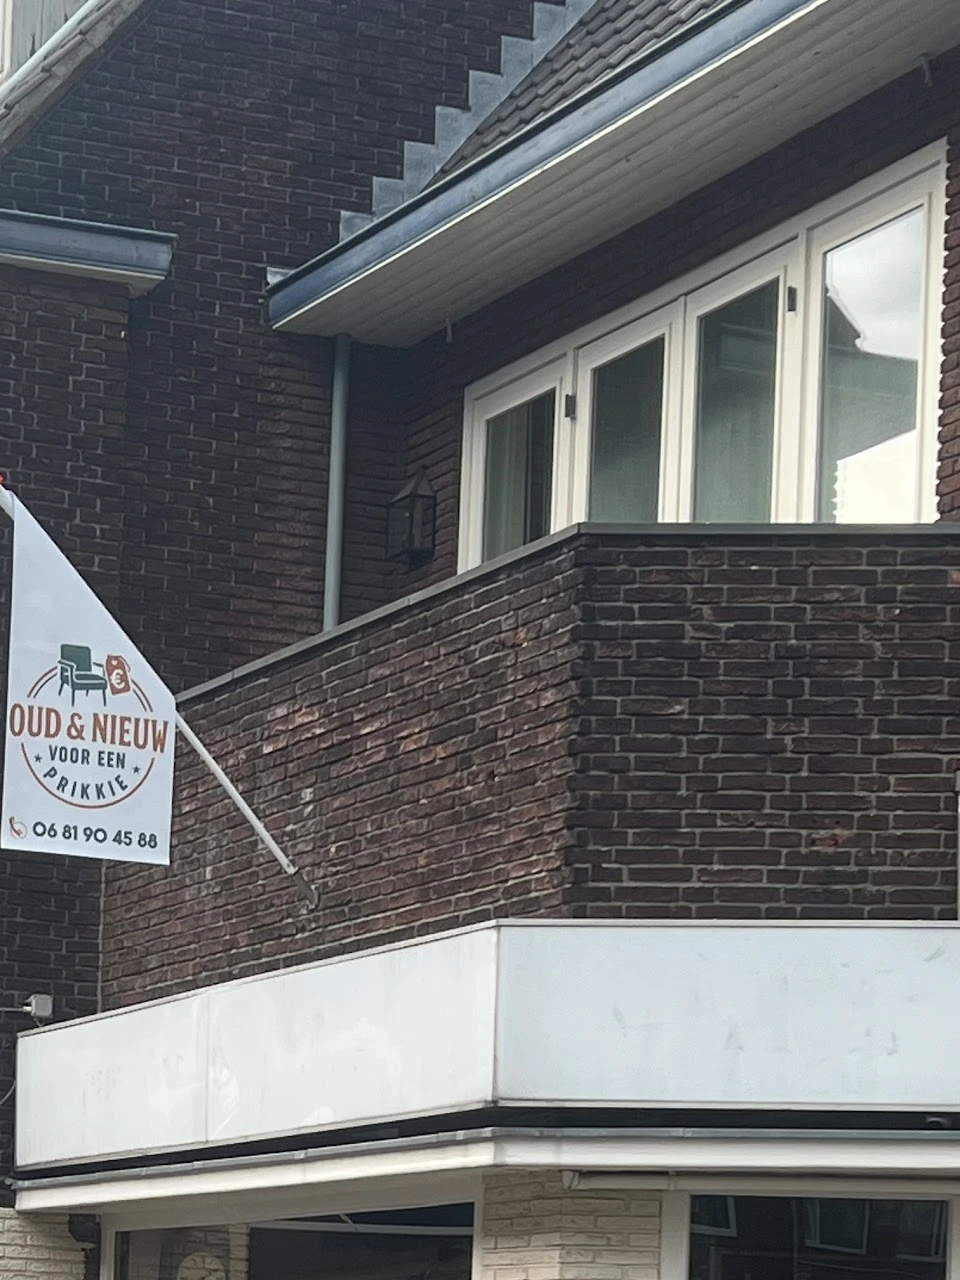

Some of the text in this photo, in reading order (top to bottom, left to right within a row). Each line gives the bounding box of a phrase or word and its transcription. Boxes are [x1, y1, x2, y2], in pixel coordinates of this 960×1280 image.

[9, 703, 168, 753] OUD & NIEUW
[49, 745, 126, 769] VOOR EEN
[43, 767, 128, 800] PRIKKIE
[33, 822, 157, 849] 06 81 90 45 88
